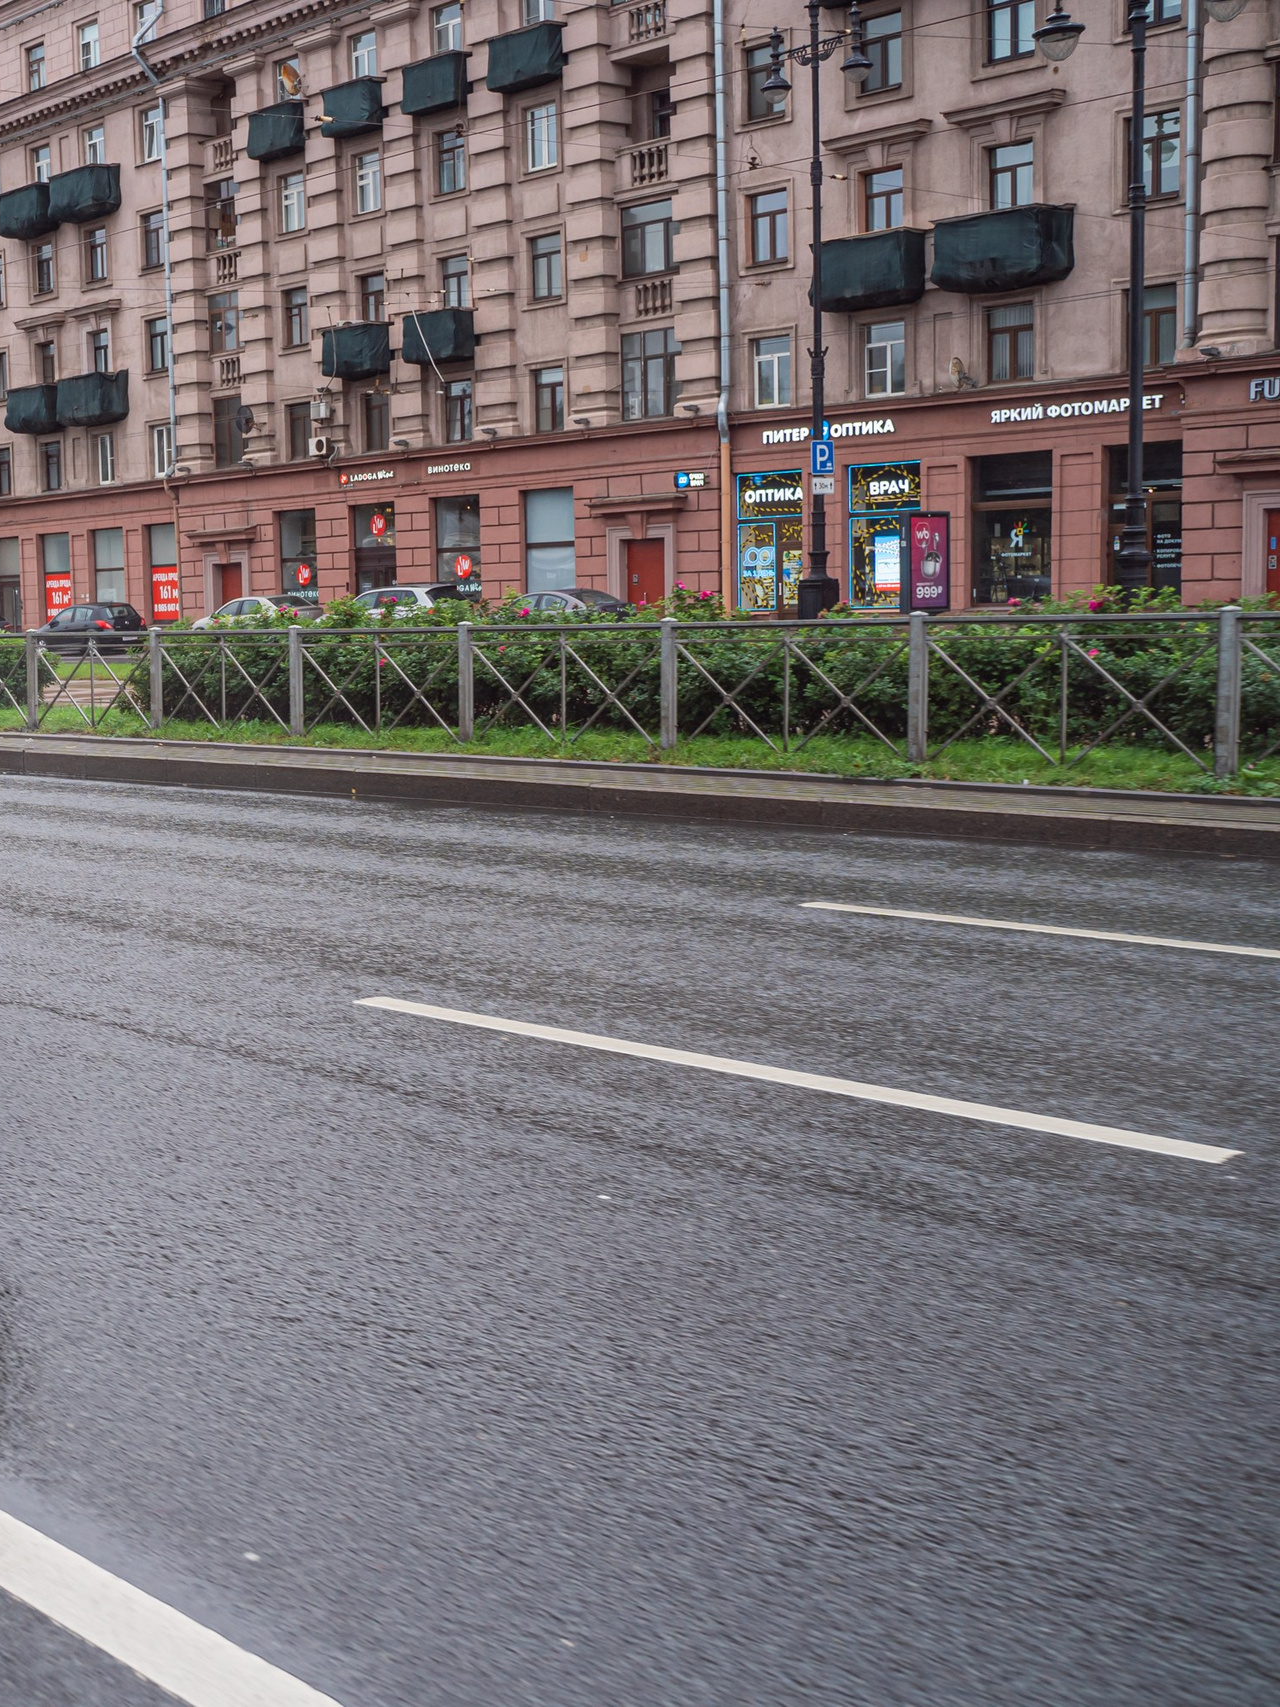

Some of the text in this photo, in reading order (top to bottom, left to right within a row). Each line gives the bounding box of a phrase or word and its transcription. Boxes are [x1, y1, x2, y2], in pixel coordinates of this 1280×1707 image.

[991, 394, 1164, 424] ЯРКИЙ ФОТОМАРЕТ
[762, 418, 895, 445] ПИТЕР ОПТИКА
[350, 473, 377, 482] LADOGA
[744, 486, 803, 504] ОПТИКА
[869, 479, 910, 496] ВРАЧ
[52, 591, 62, 605] 161
[159, 585, 171, 600] 161
